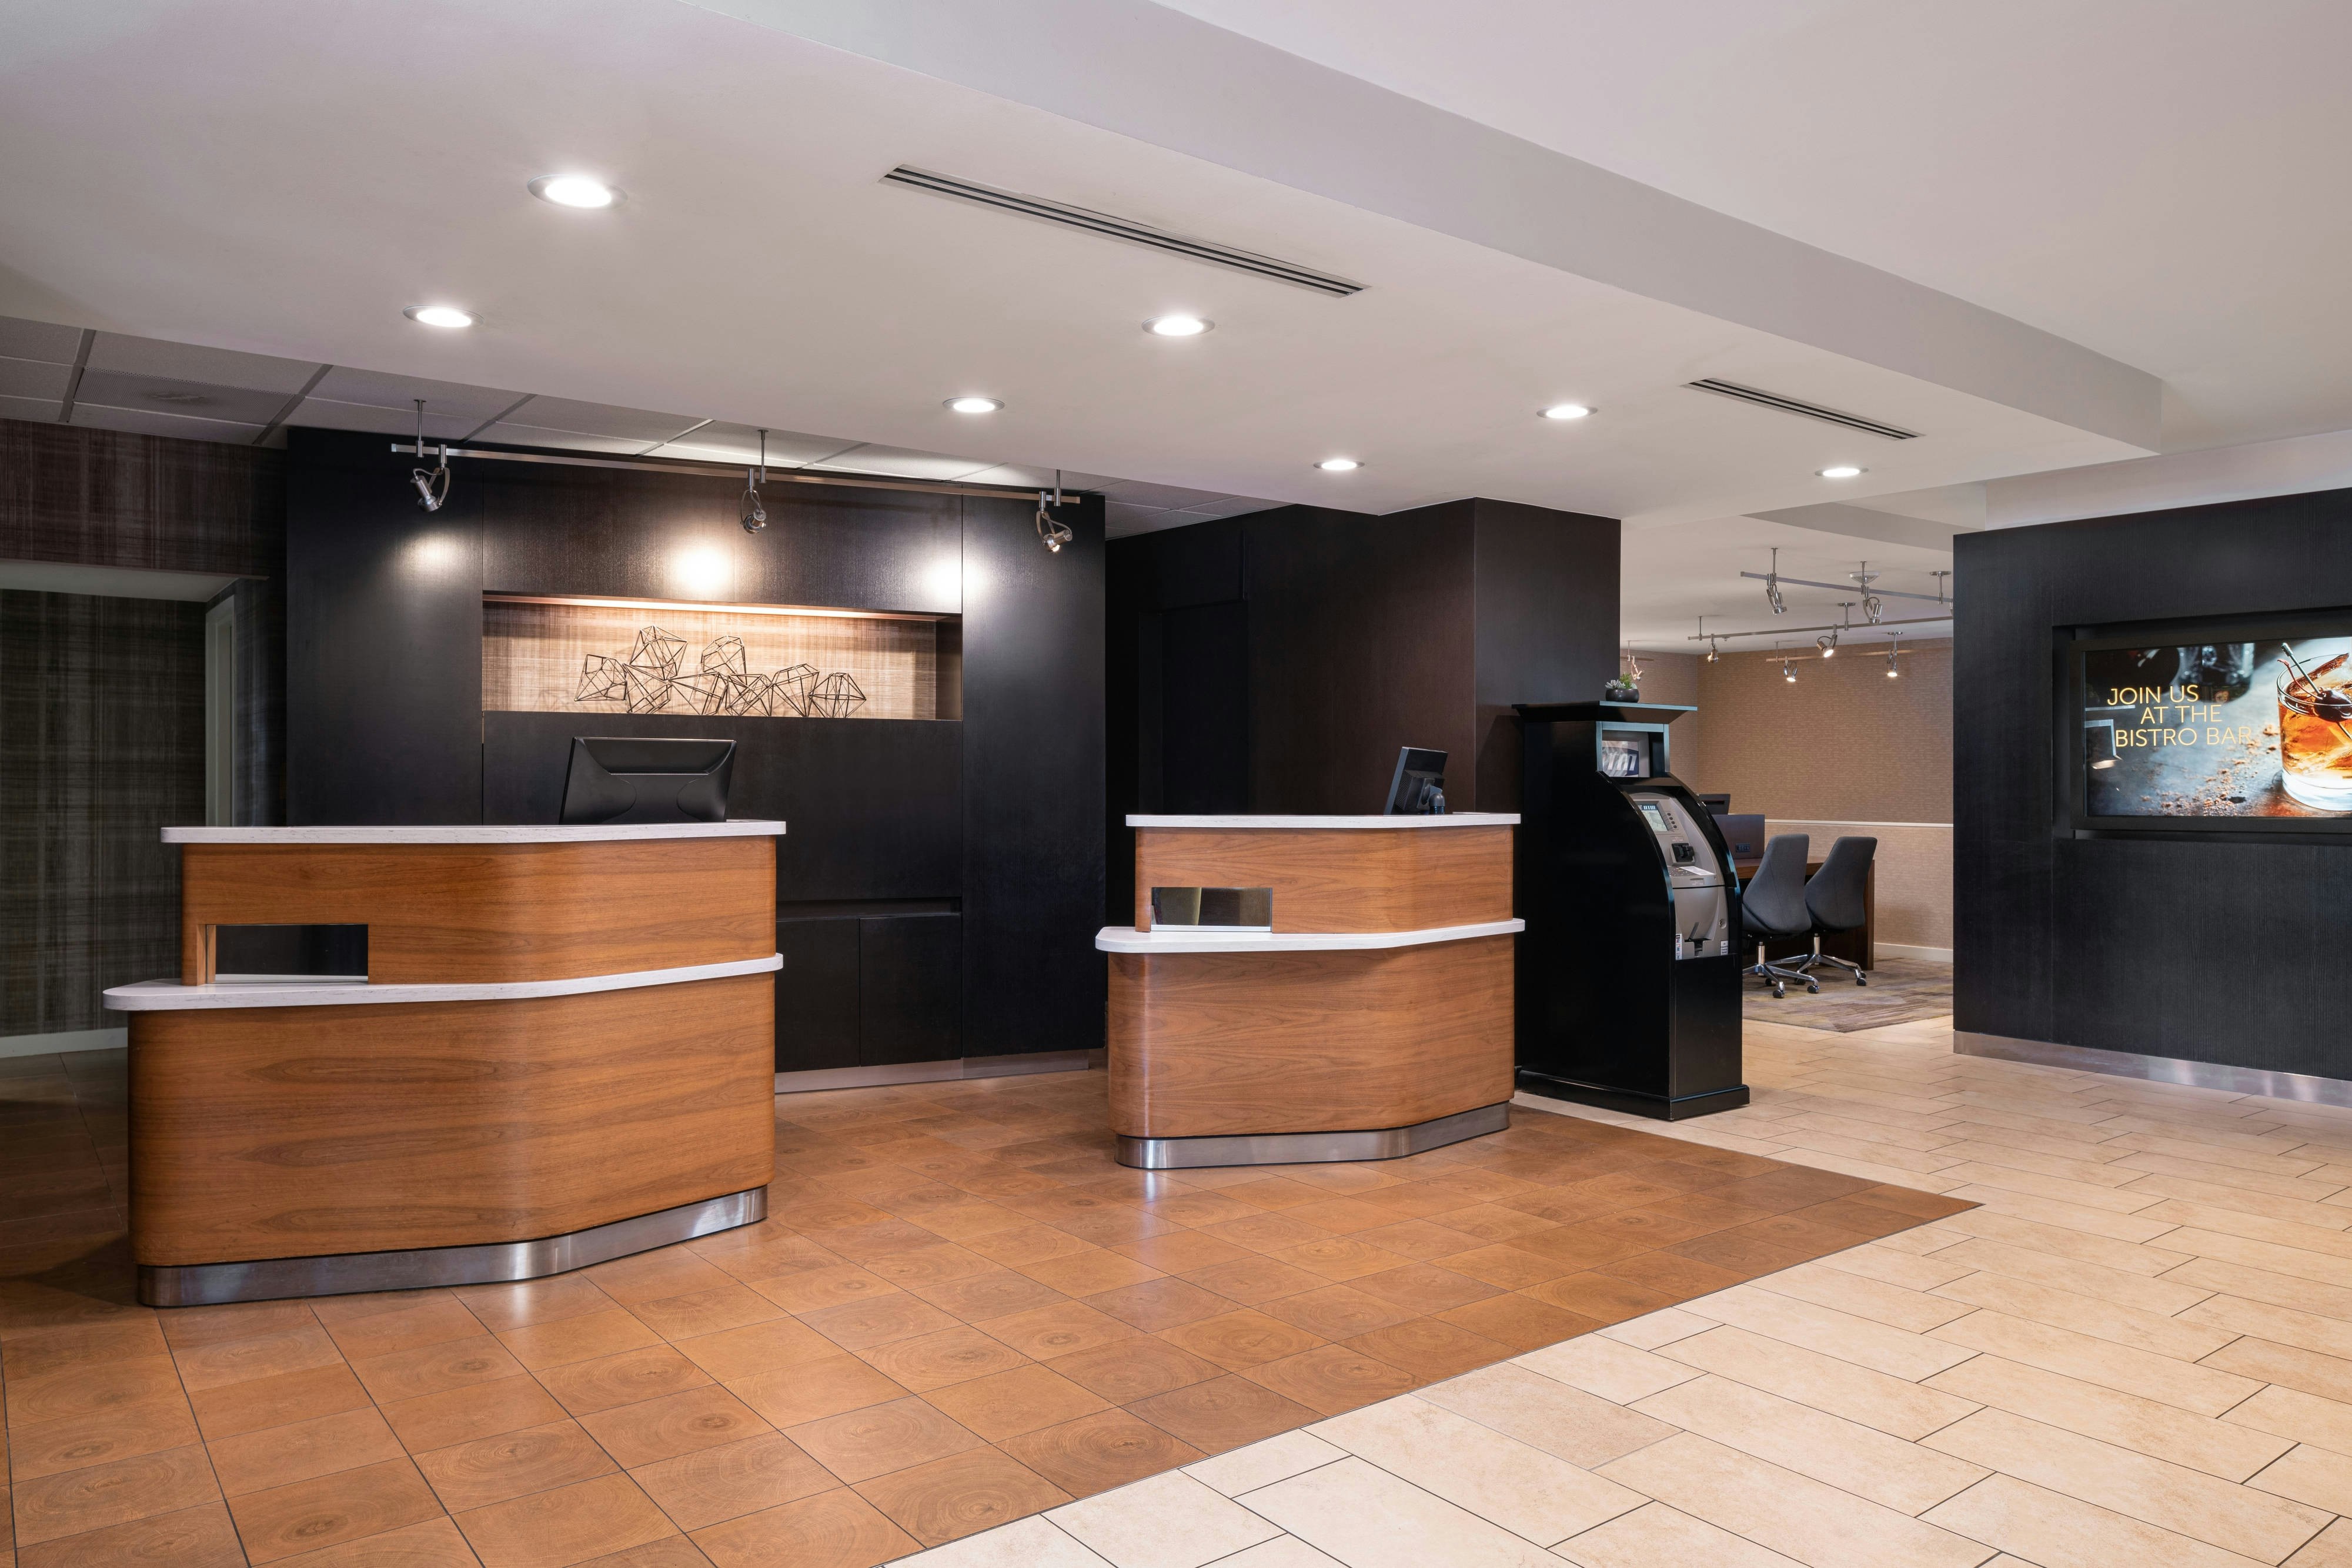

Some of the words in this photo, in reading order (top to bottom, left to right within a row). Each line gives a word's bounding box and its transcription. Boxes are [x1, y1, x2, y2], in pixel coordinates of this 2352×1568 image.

[2107, 686, 2161, 706] JOIN
[2170, 684, 2199, 703] US
[2140, 706, 2169, 724] AT
[2174, 704, 2223, 723] THE
[2115, 728, 2197, 747] BISTRO
[2206, 726, 2252, 745] BAR
